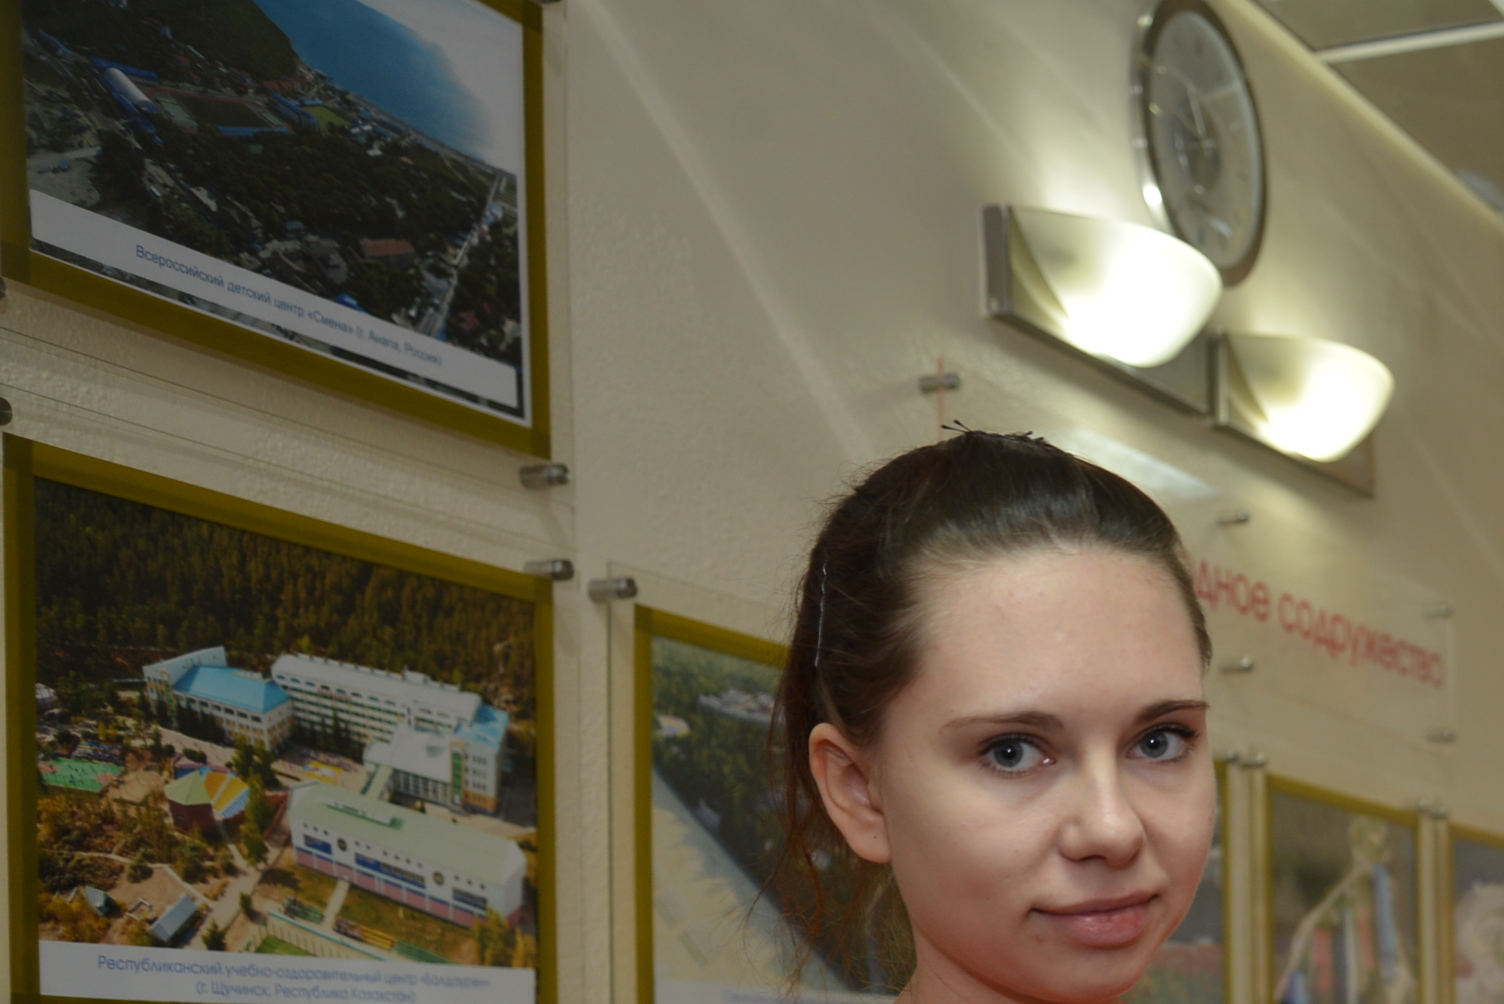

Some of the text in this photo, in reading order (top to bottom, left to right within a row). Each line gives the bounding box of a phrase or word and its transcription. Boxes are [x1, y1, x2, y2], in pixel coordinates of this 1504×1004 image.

[136, 244, 224, 288] Всероссийский
[226, 279, 272, 305] детский
[274, 298, 305, 318] центр
[307, 310, 353, 335] «Смена»
[97, 954, 222, 975] Республиканский
[224, 963, 382, 984] учебно-оздоровительный
[274, 982, 349, 1001] Республика
[351, 987, 416, 1004] Казахстан)
